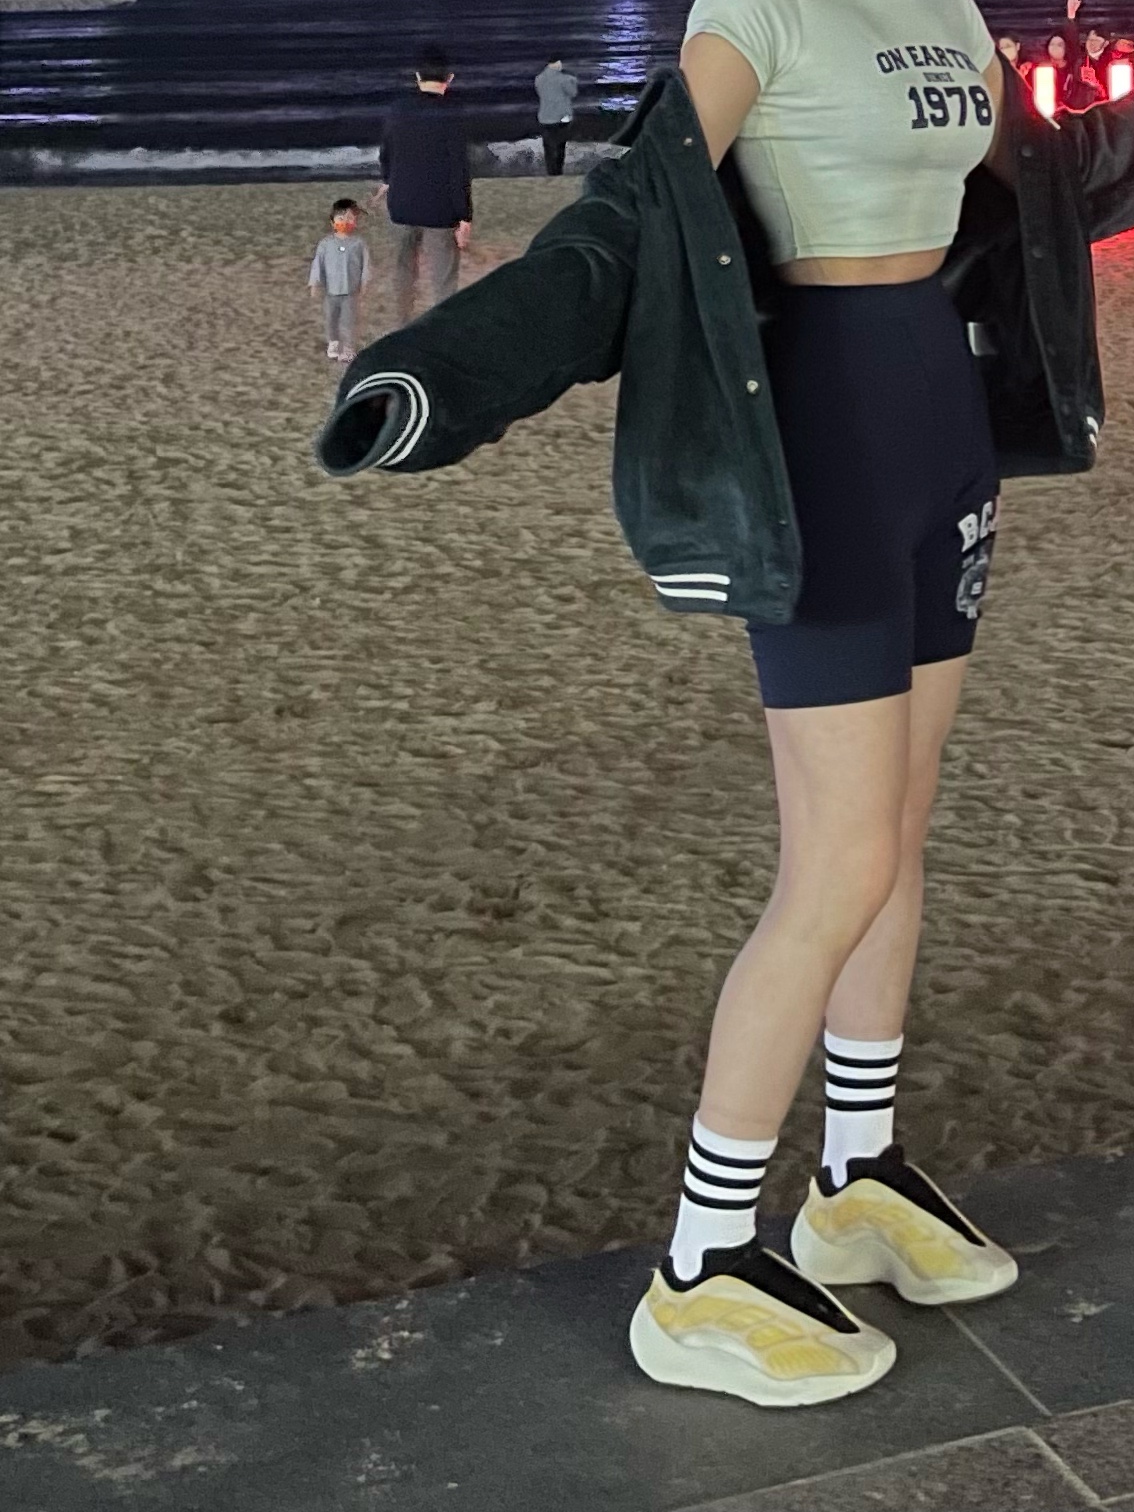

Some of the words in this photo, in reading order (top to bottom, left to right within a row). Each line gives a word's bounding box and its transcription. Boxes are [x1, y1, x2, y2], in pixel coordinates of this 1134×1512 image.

[876, 46, 909, 74] ON
[905, 45, 980, 73] EARTH
[908, 85, 993, 129] 1978
